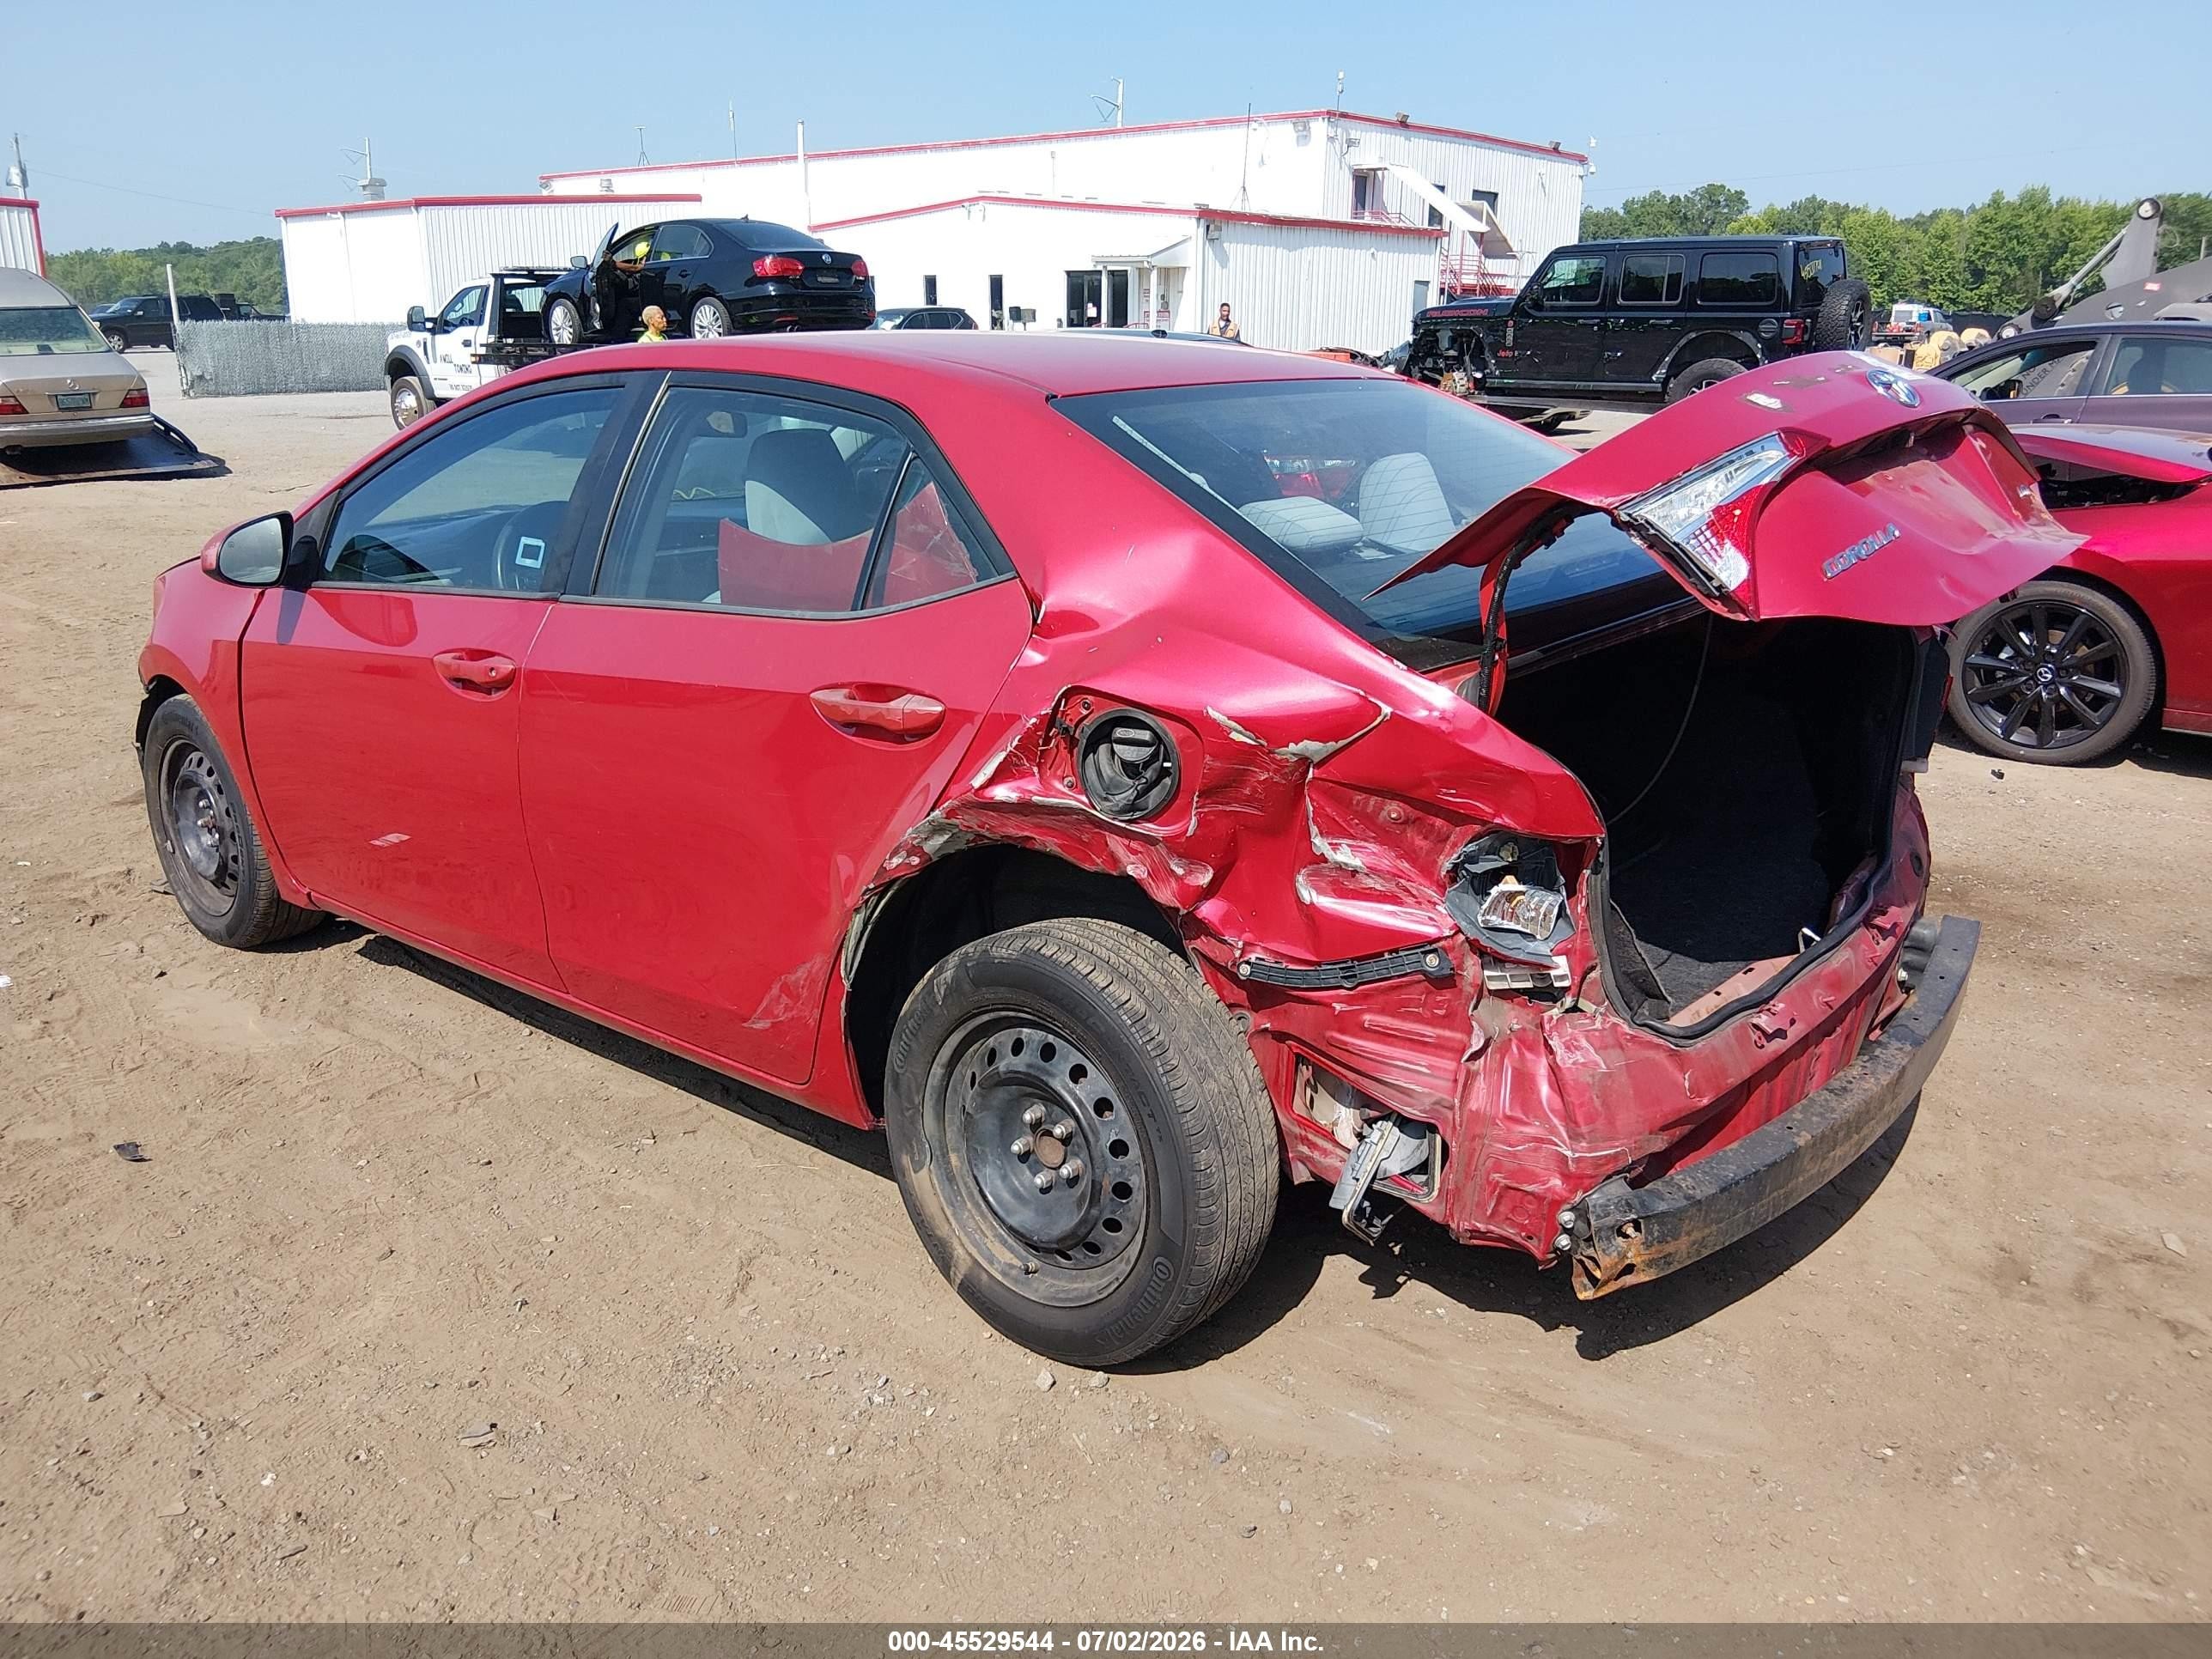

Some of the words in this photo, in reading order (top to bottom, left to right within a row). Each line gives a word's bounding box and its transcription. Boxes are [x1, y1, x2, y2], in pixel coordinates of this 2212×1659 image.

[1426, 308, 1489, 318] RUBICON
[2021, 368, 2051, 396] UNDER
[1821, 522, 1901, 580] COROLLA
